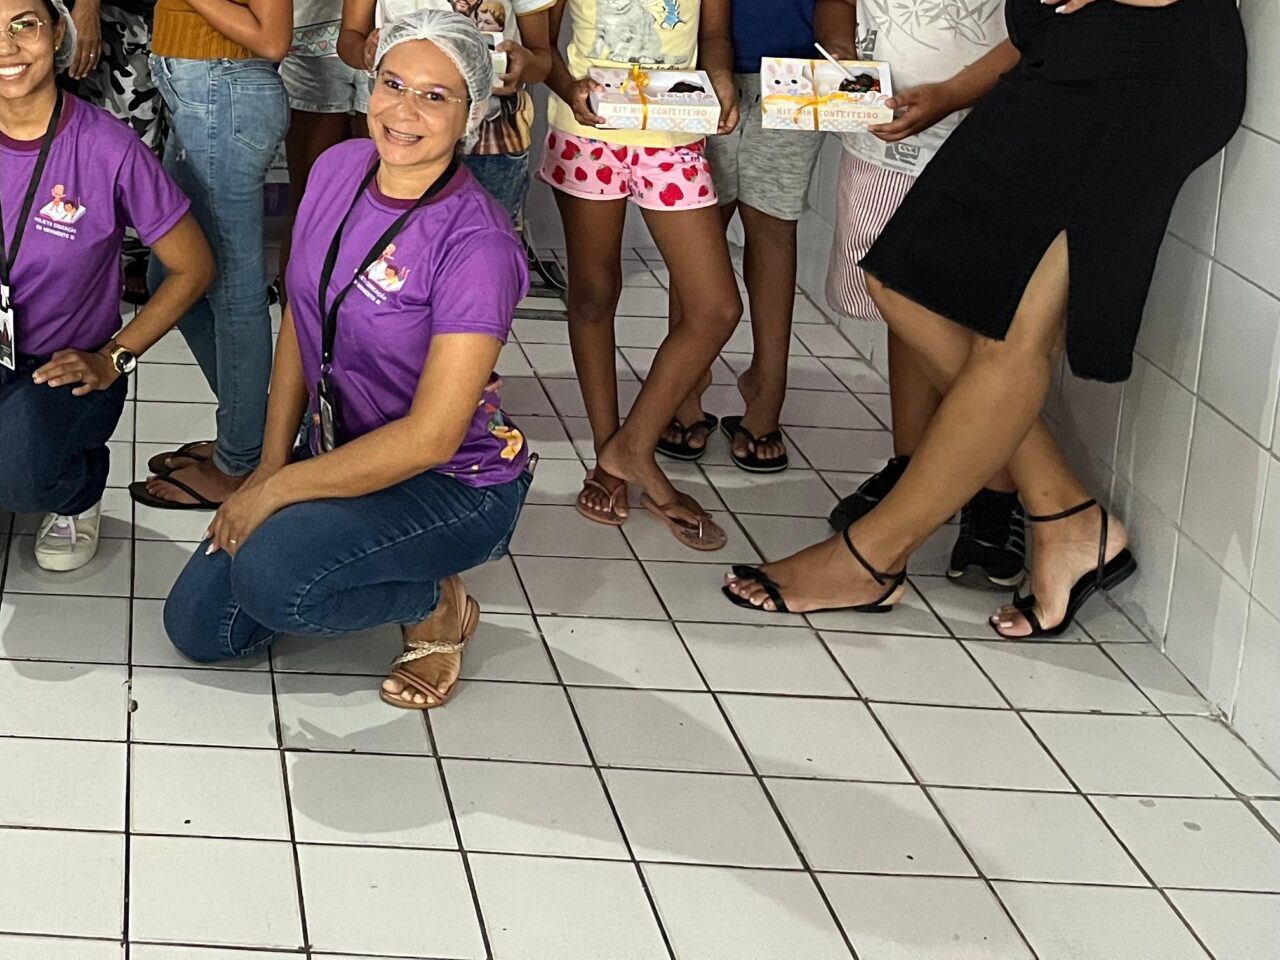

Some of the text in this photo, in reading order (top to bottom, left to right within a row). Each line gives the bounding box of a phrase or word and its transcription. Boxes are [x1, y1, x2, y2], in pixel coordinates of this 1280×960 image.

[613, 106, 628, 114] KIT
[651, 107, 708, 118] CONFEITEIRO
[776, 108, 792, 116] KIT
[819, 109, 879, 120] CONFEITEIRO
